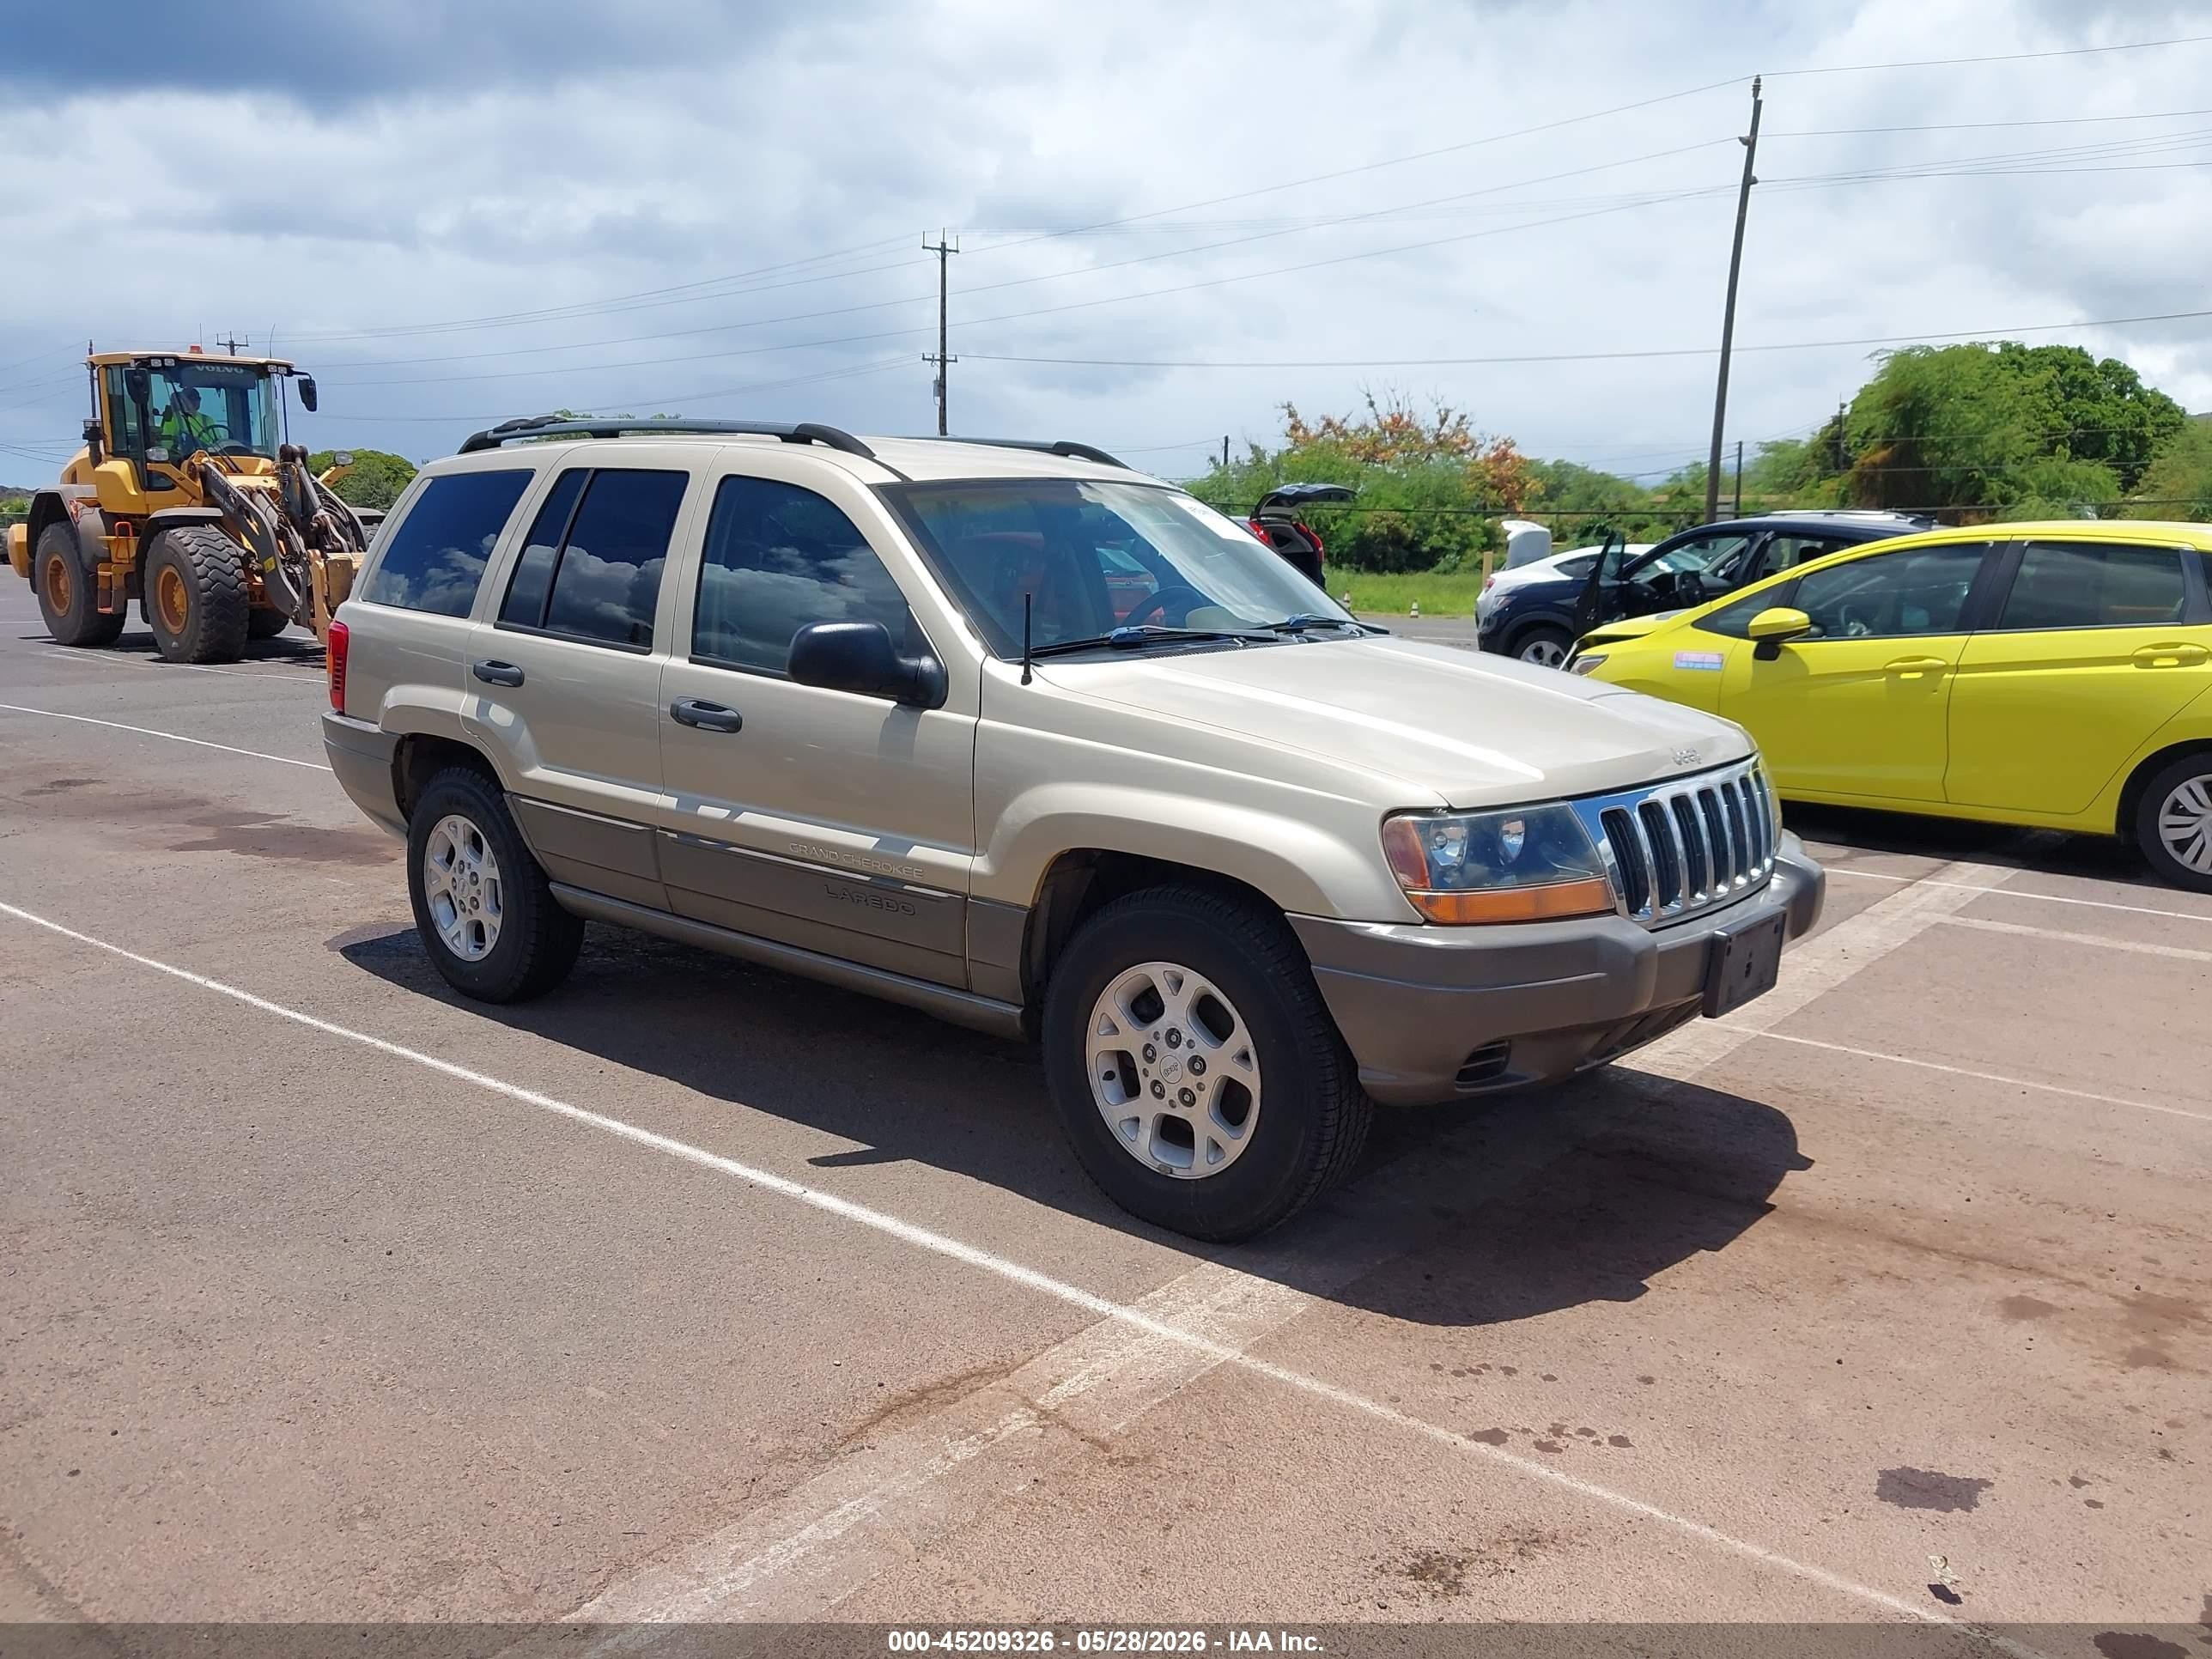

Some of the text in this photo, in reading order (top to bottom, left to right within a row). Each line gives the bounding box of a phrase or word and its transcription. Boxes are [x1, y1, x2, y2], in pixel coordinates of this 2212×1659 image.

[195, 364, 245, 374] VOLVO
[1669, 746, 1702, 766] Jeep
[789, 842, 925, 879] GRAND CHEROKEE
[823, 884, 916, 916] LAREDO
